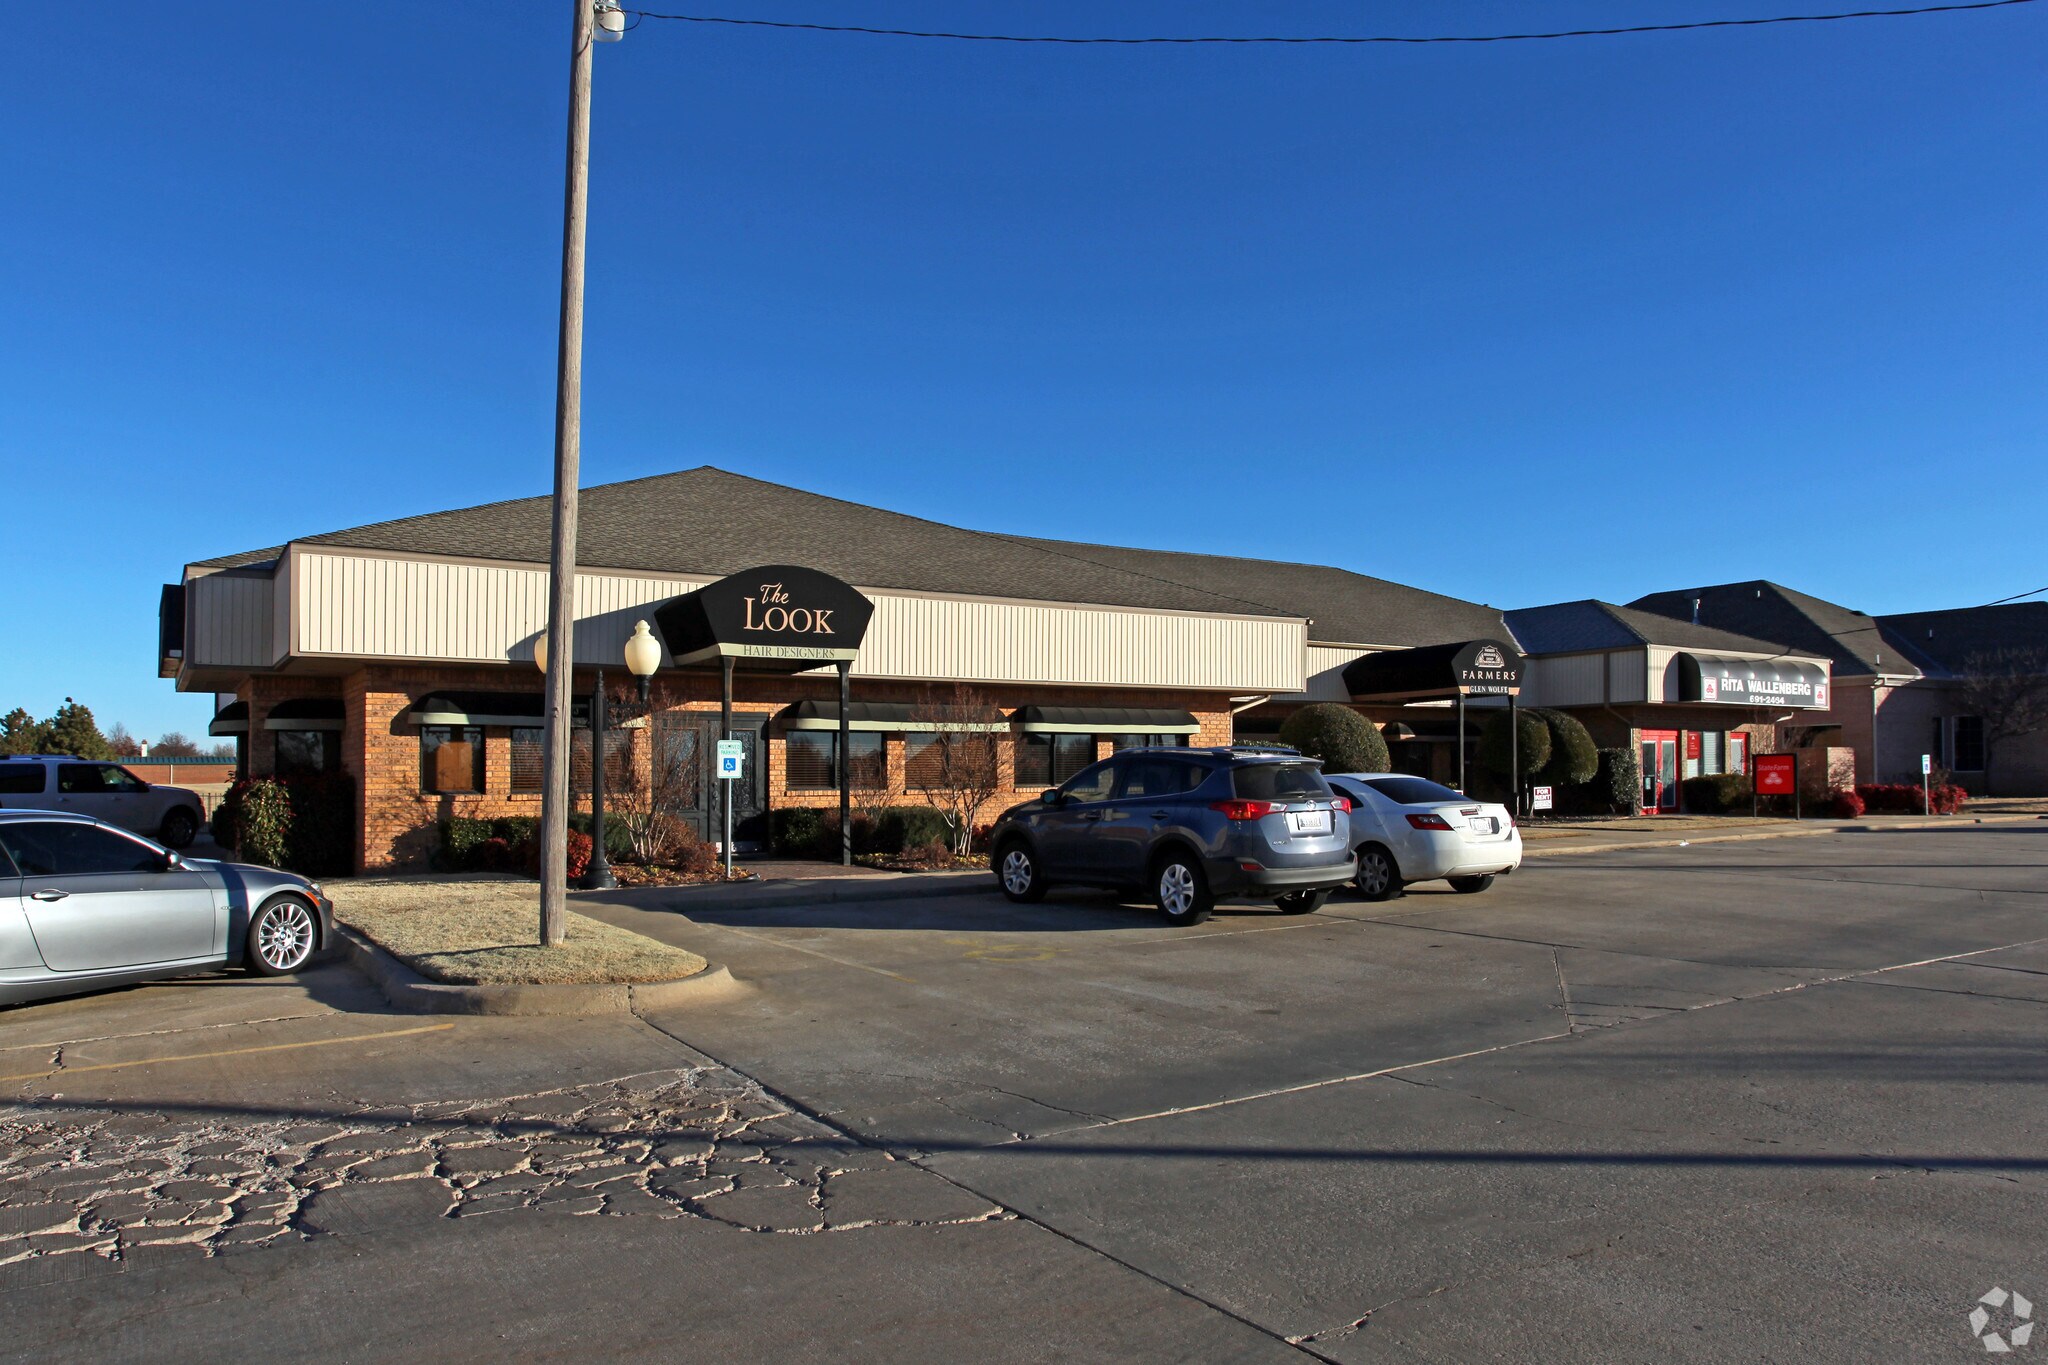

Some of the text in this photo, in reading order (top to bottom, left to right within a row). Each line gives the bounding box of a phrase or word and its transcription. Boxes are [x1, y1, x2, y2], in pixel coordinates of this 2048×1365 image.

[760, 582, 790, 605] The
[743, 597, 835, 634] LOOK
[743, 645, 835, 659] HAIR DESIGNERS
[1462, 671, 1516, 680] FARMERS
[1470, 685, 1486, 693] GLEN
[1721, 678, 1811, 695] RITA WALLENBERG
